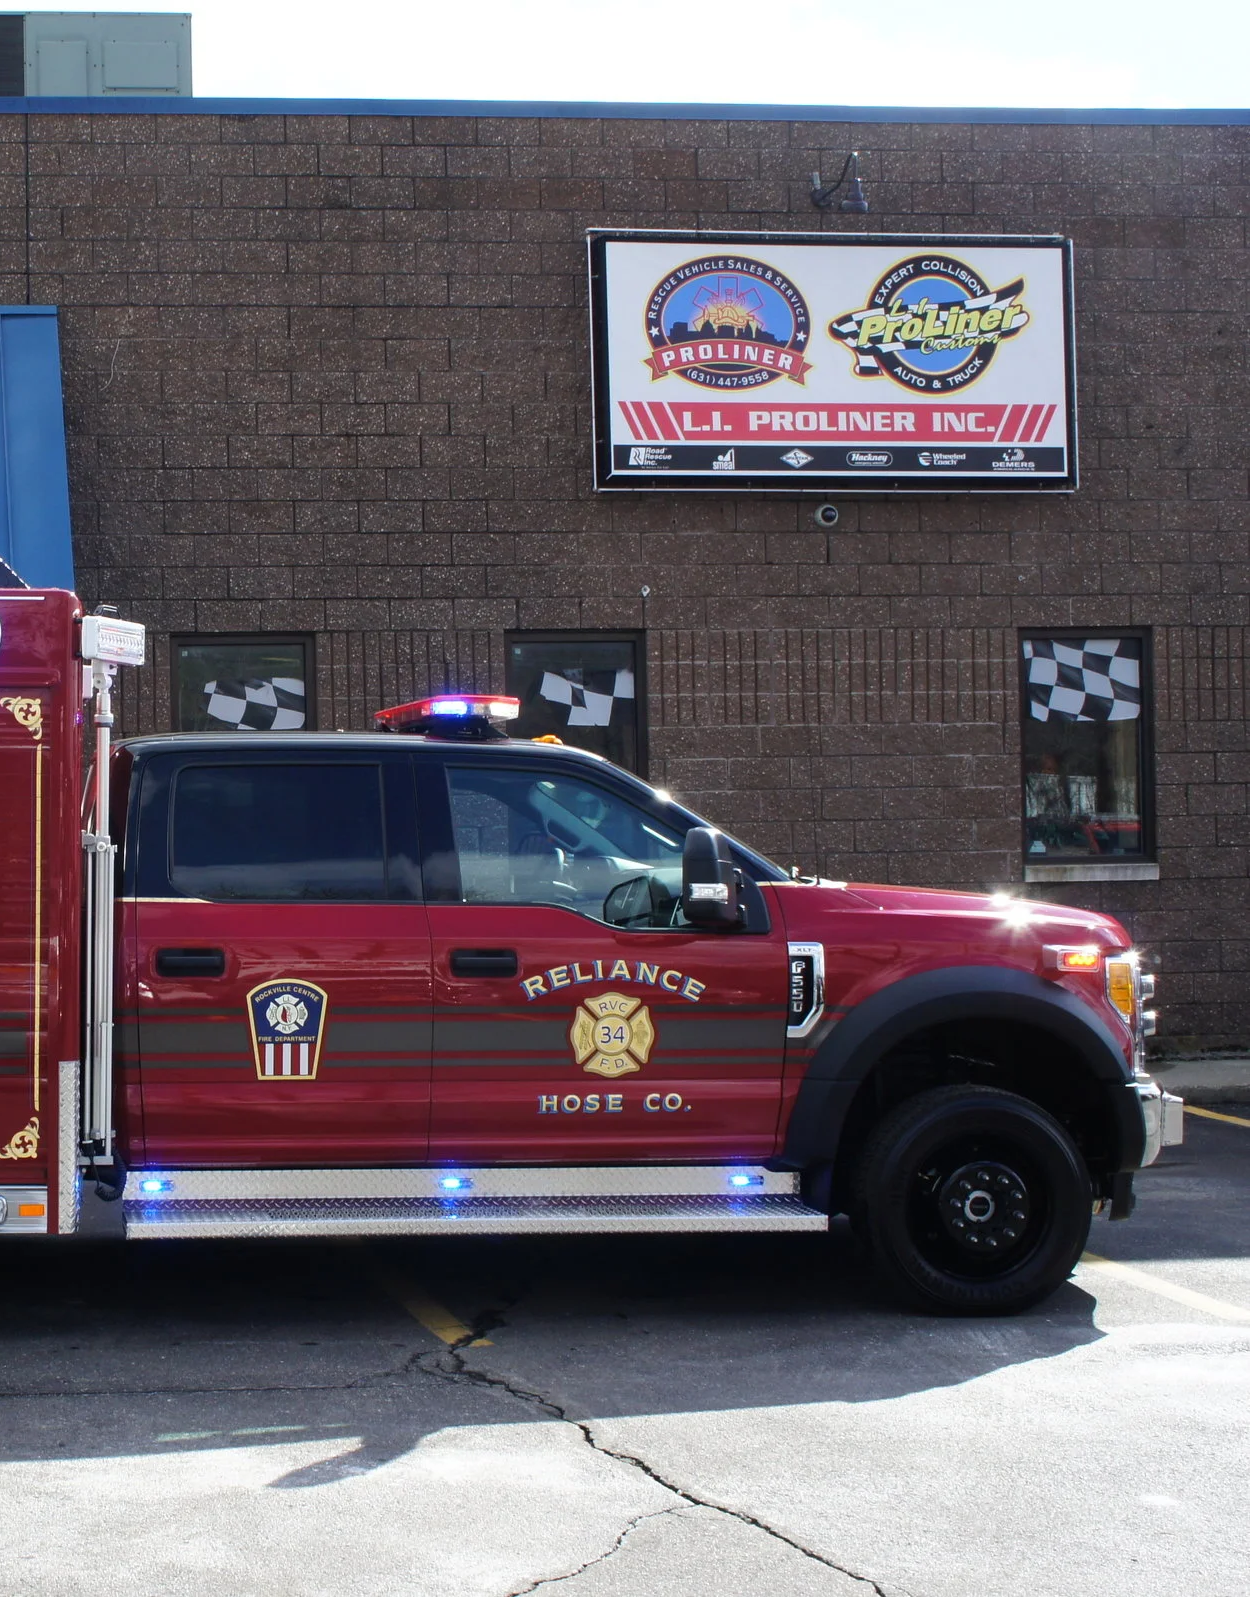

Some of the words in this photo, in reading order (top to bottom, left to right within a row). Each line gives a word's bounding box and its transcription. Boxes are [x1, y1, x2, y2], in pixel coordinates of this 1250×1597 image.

[648, 278, 677, 319] RESCUE
[677, 260, 725, 279] VEHICLE
[728, 259, 763, 275] SALES
[764, 270, 773, 280] &
[773, 276, 806, 323] SERVICE
[874, 263, 914, 305] EXPERT
[921, 261, 984, 297] COLLISION
[857, 304, 1023, 347] ProLiner
[920, 331, 1001, 355] Customs
[661, 343, 794, 371] PROLINER
[687, 368, 716, 385] (631)
[717, 371, 769, 386] 447-9558
[894, 366, 926, 387] AUTO
[932, 380, 942, 389] &
[946, 357, 983, 388] TRUCK
[682, 411, 732, 431] L.I.
[749, 411, 915, 432] PROLINER
[932, 411, 995, 432] INC.
[851, 453, 888, 462] Hackney
[520, 959, 706, 1002] RELIANCE
[255, 986, 291, 1003] ROCKVILLE
[293, 986, 320, 1002] CENTRE
[598, 1000, 628, 1013] RVC
[600, 1026, 625, 1044] 34
[537, 1094, 623, 1114] HOSE
[643, 1093, 692, 1114] CO.
